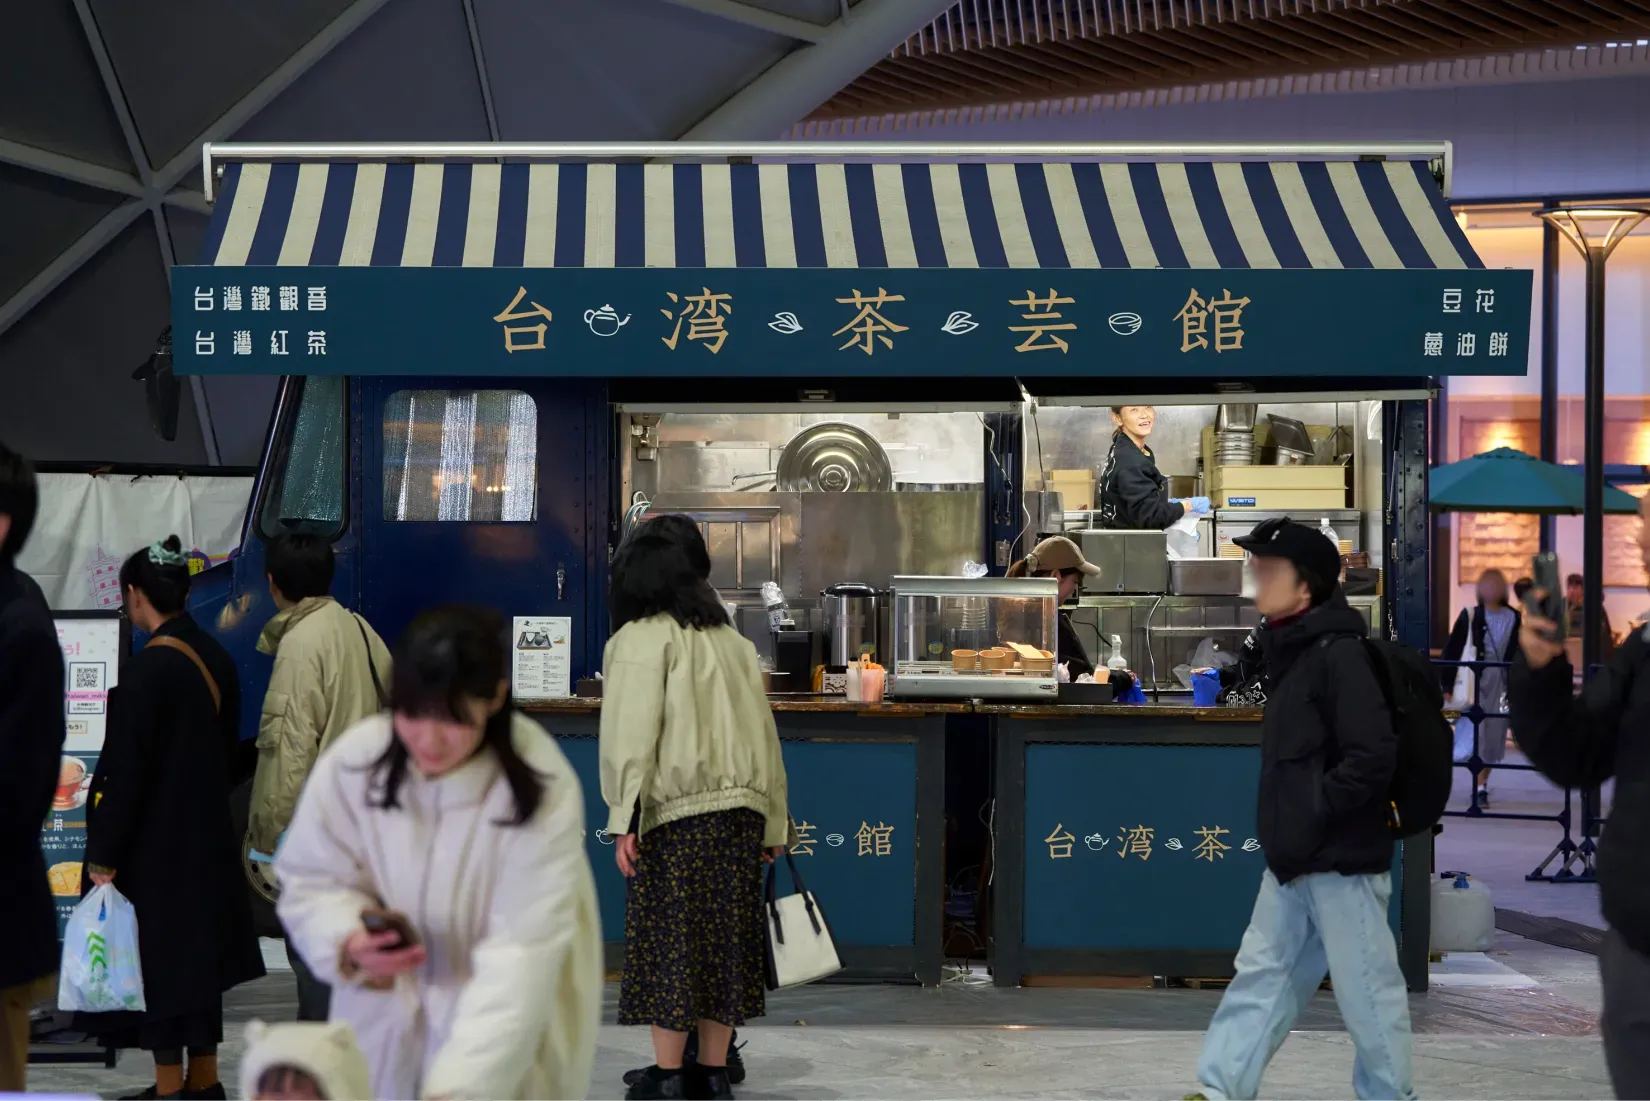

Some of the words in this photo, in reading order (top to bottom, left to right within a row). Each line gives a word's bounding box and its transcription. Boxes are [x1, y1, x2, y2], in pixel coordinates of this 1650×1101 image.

[194, 286, 327, 311] 台灣鐵觀音
[1443, 288, 1495, 313] 豆花
[195, 330, 327, 355] 台灣紅茶
[1044, 823, 1232, 863] 台湾茶
